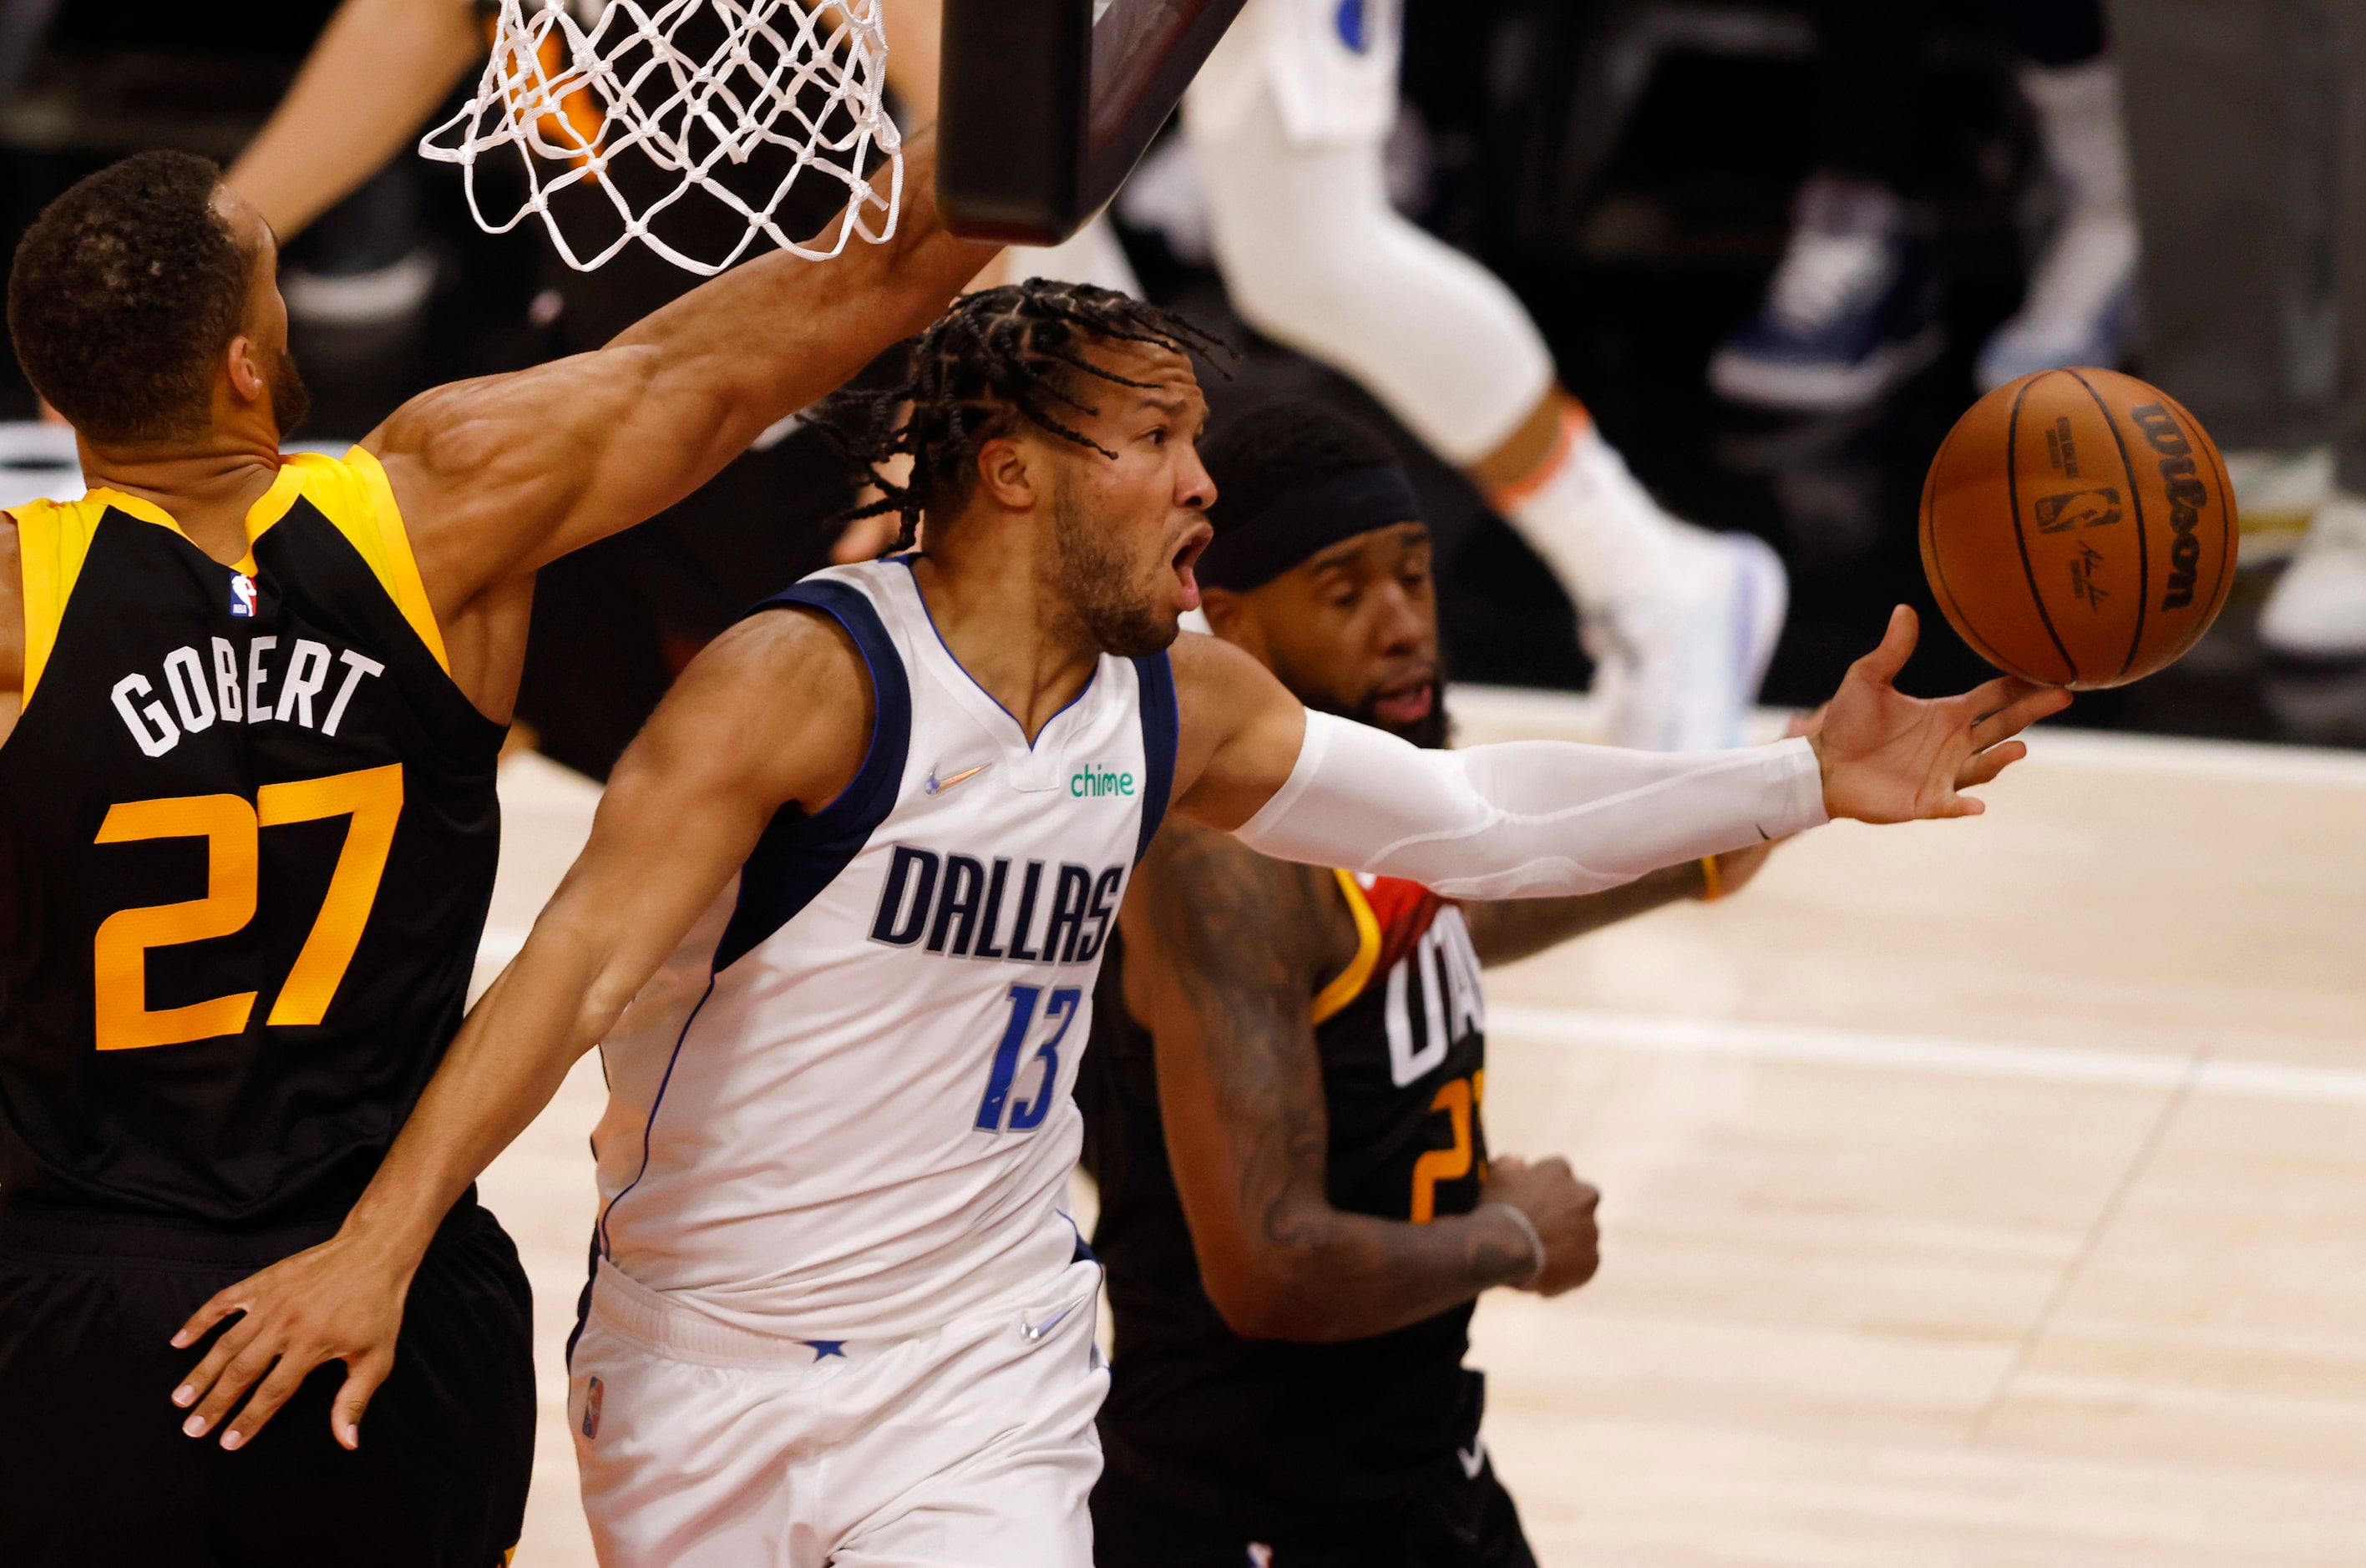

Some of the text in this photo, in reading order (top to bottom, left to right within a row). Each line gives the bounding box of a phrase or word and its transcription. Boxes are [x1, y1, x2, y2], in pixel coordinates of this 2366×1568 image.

[2130, 402, 2207, 612] Wilson
[110, 635, 385, 757] GOBERT
[1071, 764, 1135, 797] chime
[94, 762, 403, 1050] 27
[867, 841, 1127, 966] DALLAS
[972, 981, 1091, 1134] 13
[1411, 1069, 1489, 1224] 2
